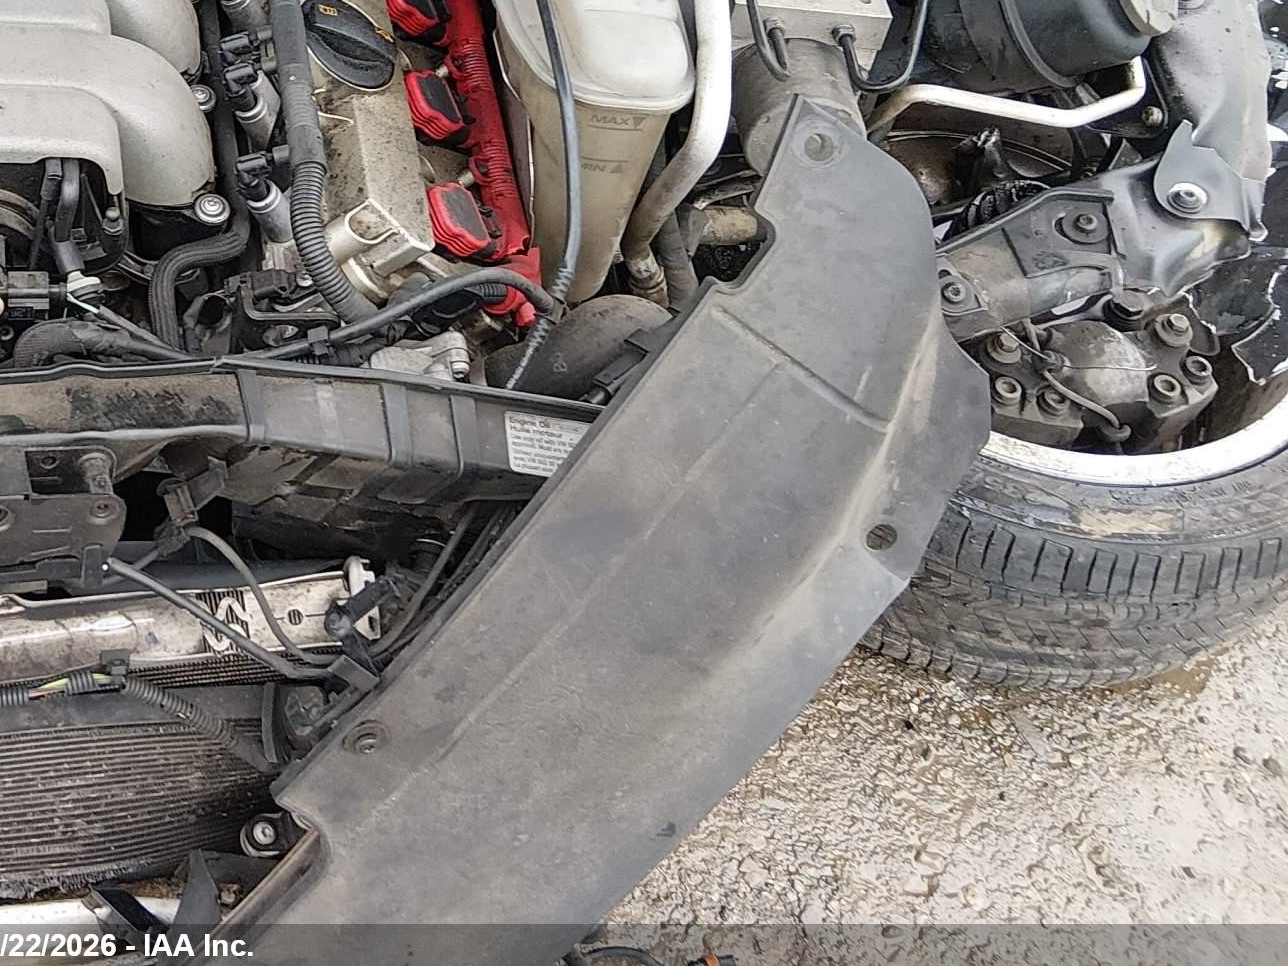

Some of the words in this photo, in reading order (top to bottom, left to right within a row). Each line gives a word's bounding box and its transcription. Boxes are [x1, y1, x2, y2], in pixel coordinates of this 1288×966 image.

[591, 114, 631, 126] MAX
[509, 416, 537, 426] Engine
[510, 425, 530, 433] Huile
